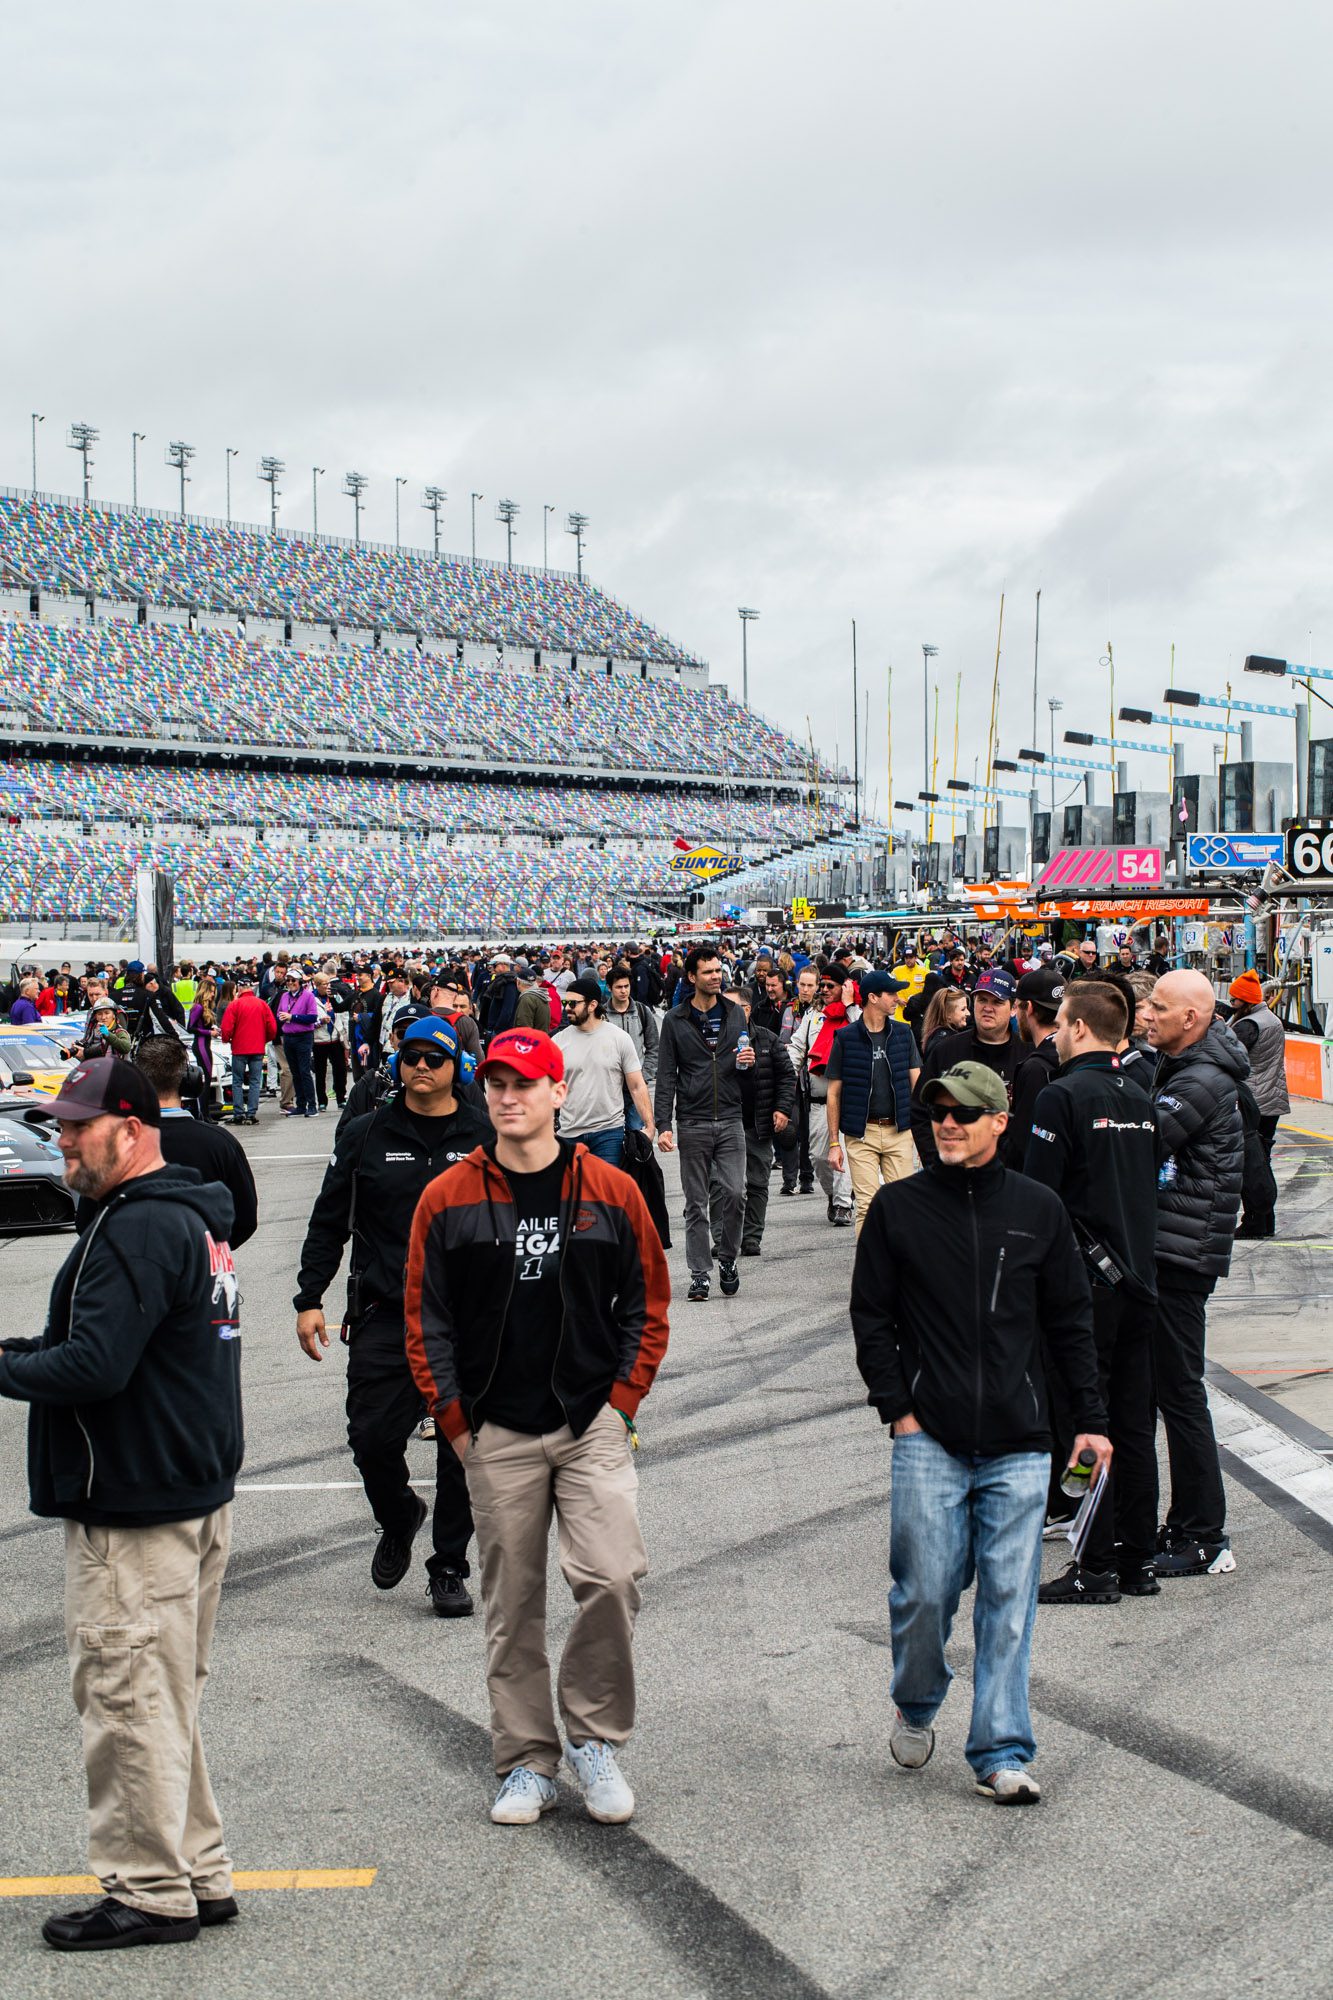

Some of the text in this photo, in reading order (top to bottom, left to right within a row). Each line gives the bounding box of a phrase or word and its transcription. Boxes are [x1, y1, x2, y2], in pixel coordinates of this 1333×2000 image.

[1189, 836, 1230, 867] 38
[673, 857, 741, 869] SUNOCO
[1121, 853, 1156, 879] 54
[1092, 901, 1143, 912] RANCH
[1144, 898, 1205, 911] RESORT
[809, 908, 816, 919] 2
[1108, 1119, 1141, 1132] Supra
[516, 1217, 559, 1231] AILIE
[515, 1233, 560, 1255] EGA
[520, 1256, 543, 1280] 1
